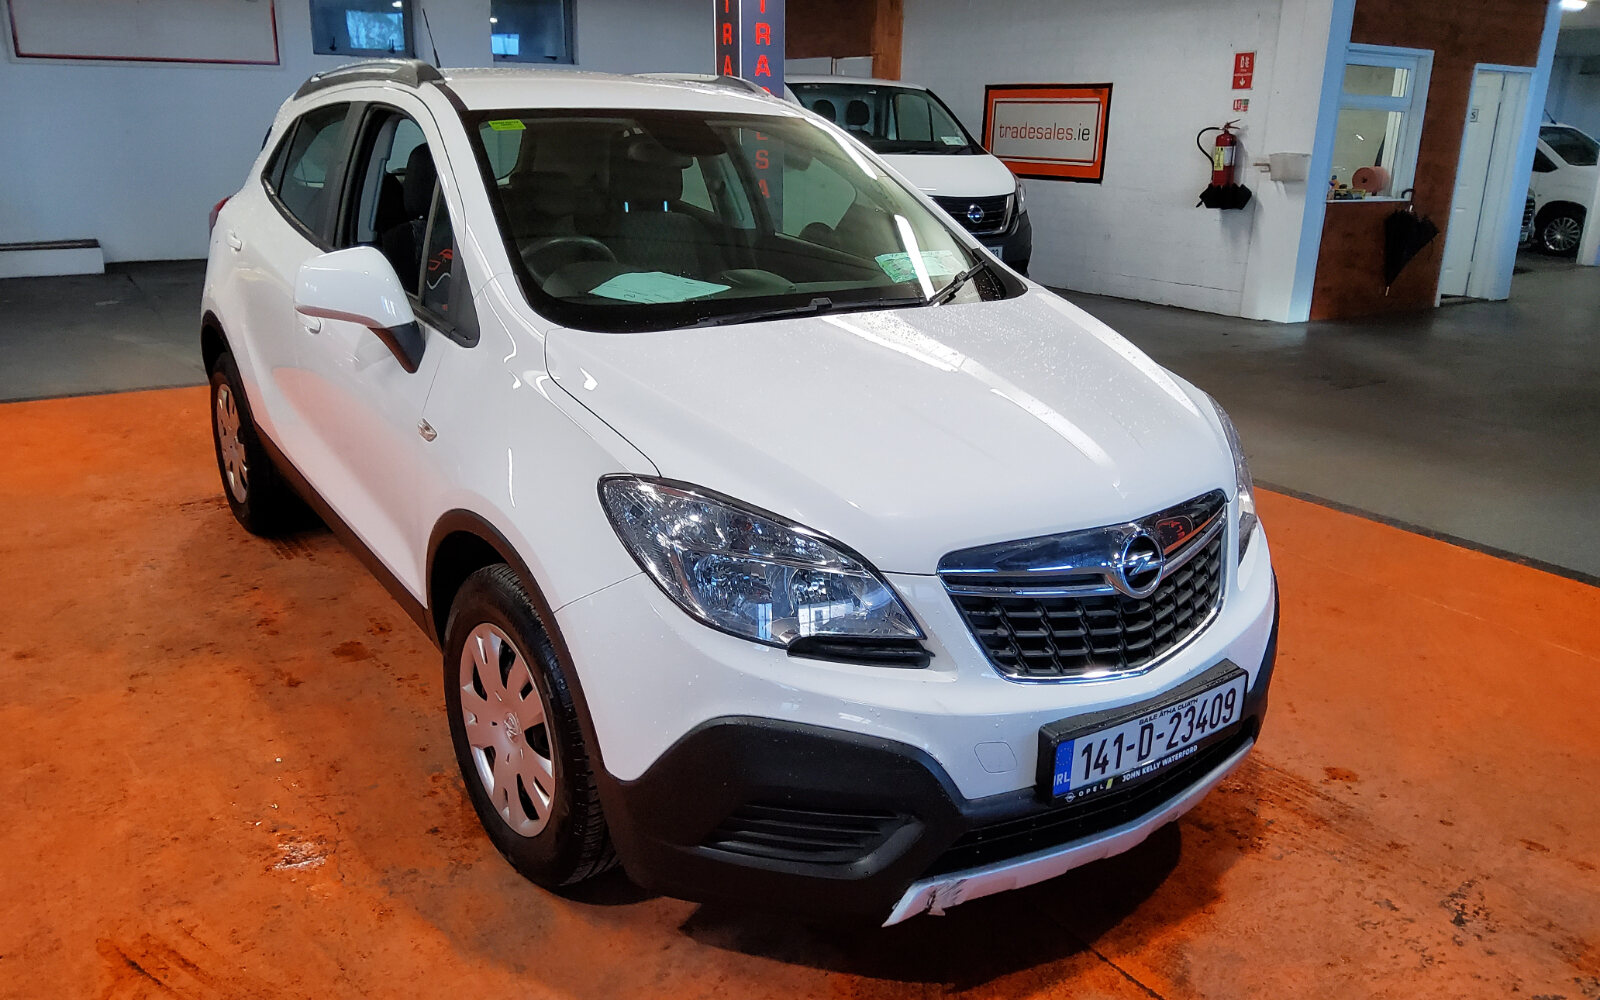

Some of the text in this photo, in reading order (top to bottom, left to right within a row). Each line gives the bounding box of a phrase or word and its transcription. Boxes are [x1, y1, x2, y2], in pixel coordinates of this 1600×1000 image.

[999, 121, 1090, 141] tradesales.ie
[1081, 687, 1237, 780] 141-D-23409
[1078, 744, 1198, 797] OPEL JOHN KELLY WATERFORD
